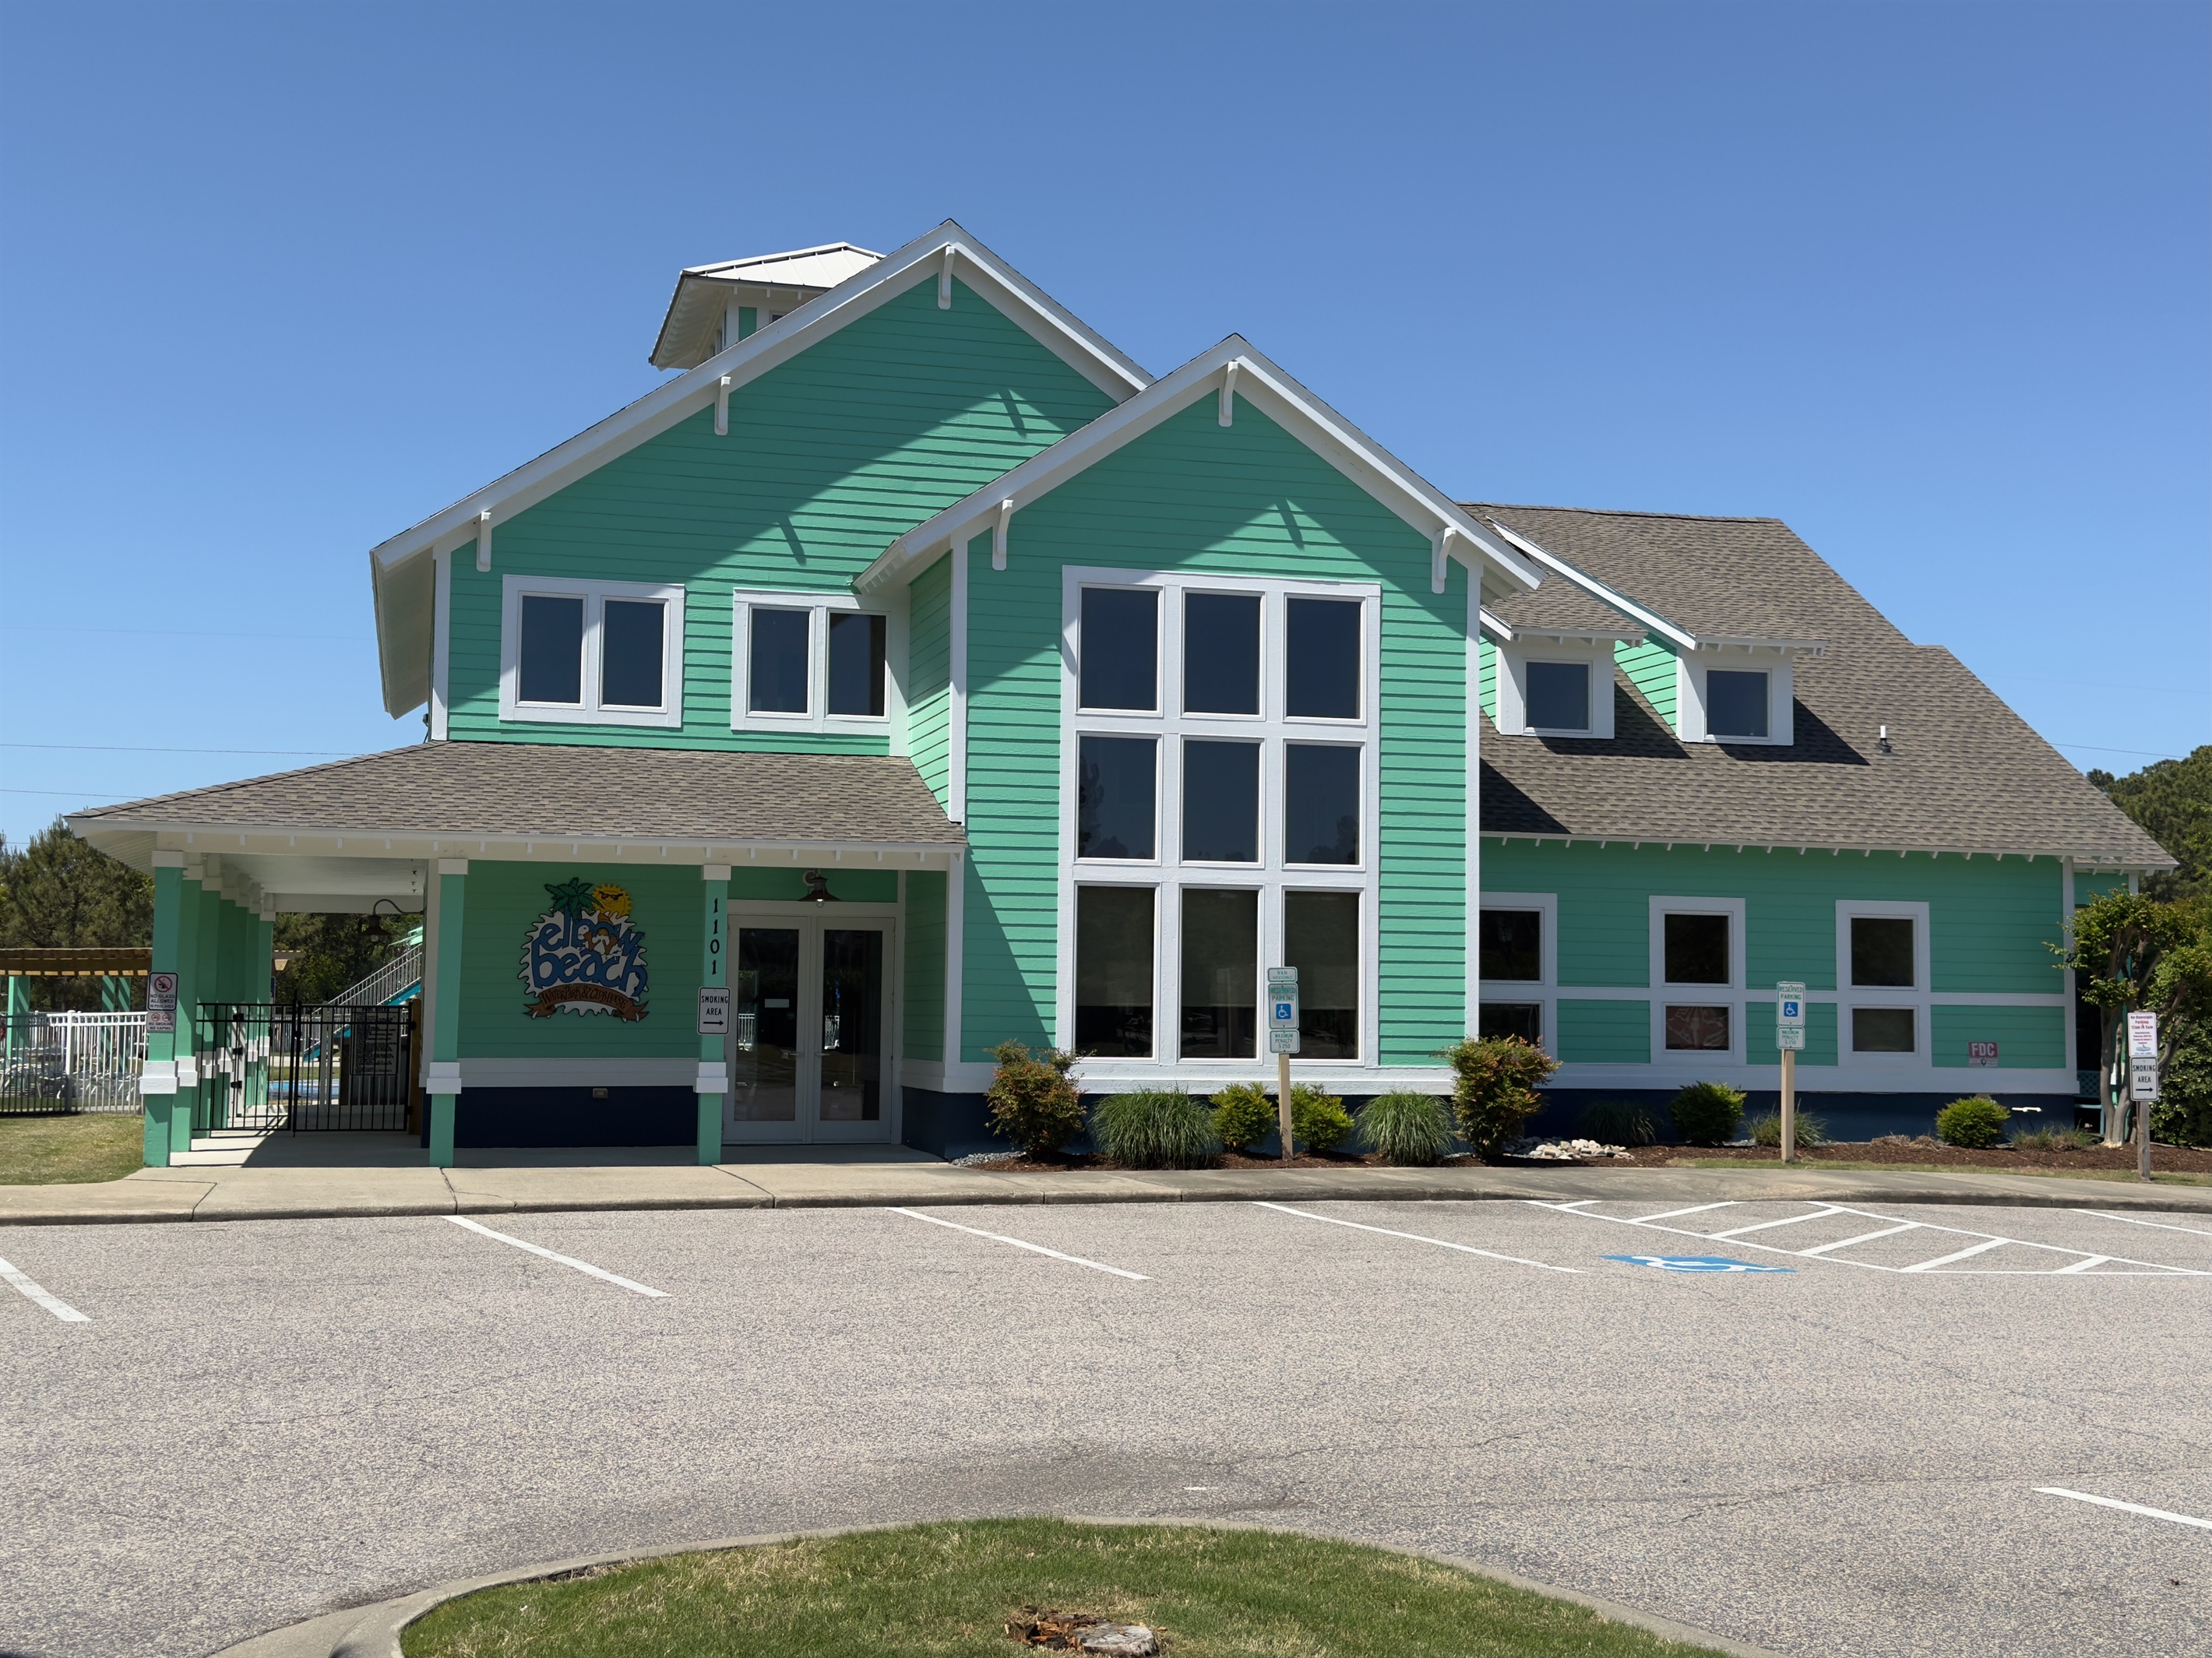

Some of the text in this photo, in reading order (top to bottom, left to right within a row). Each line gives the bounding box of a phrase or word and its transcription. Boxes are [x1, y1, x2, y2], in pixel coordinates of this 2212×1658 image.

[710, 898, 720, 975] 1101
[531, 939, 648, 997] beach
[701, 995, 728, 1004] SMOKING
[1971, 1043, 1995, 1057] FDC
